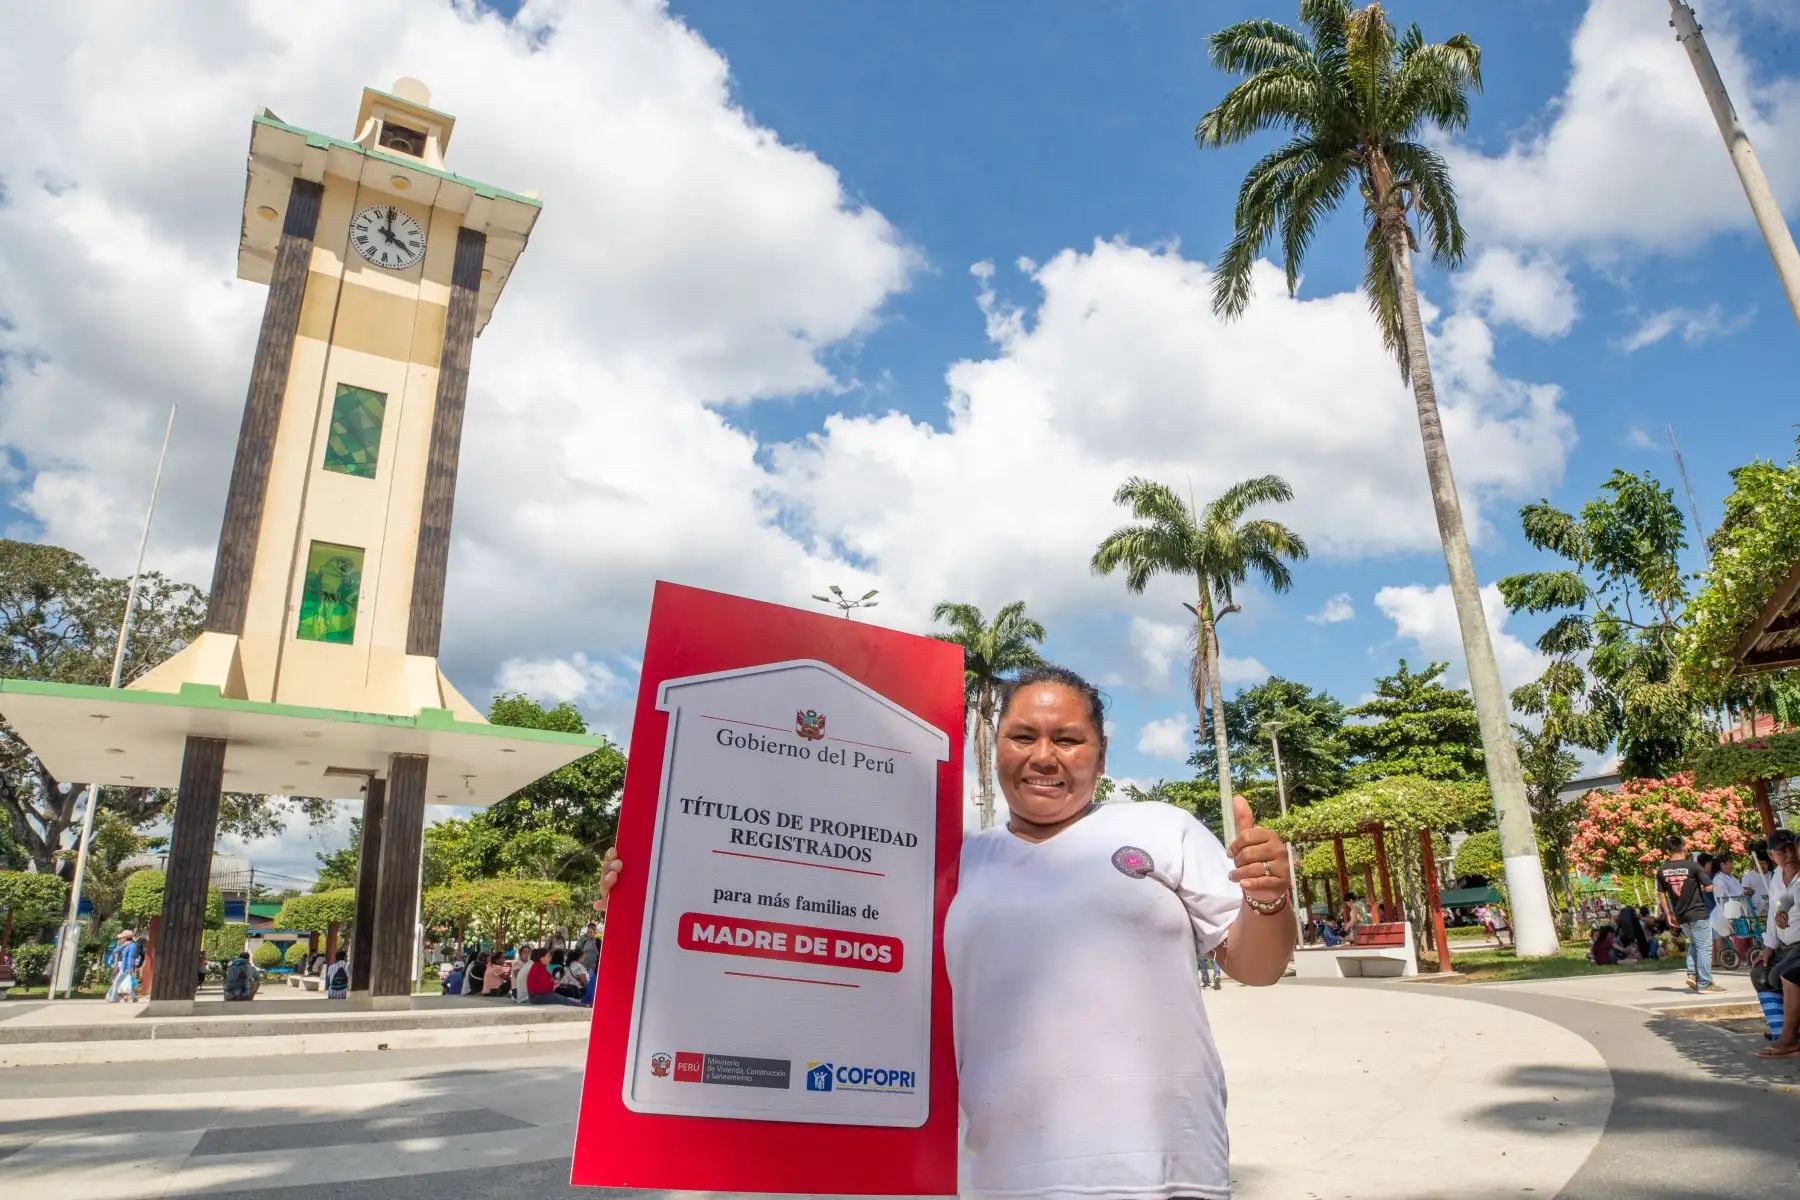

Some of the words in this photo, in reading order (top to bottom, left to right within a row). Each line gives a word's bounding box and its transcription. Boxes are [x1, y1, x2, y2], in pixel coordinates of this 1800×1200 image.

[716, 728, 811, 760] Gobierno
[817, 746, 846, 766] del
[853, 751, 895, 775] Perú
[680, 796, 770, 826] TÍTULOS
[776, 812, 803, 830] DE
[809, 817, 918, 848] PROPIEDAD
[730, 828, 872, 863] REGISTRADOS
[713, 888, 752, 904] para
[757, 893, 790, 909] más
[796, 896, 857, 917] familias
[862, 905, 880, 920] de
[692, 923, 787, 952] MADRE
[795, 935, 828, 957] DE
[835, 939, 893, 964] DIOS
[677, 1061, 700, 1072] PERÚ
[707, 1057, 740, 1066] Ministerio
[716, 1065, 744, 1075] Vivienda,
[746, 1068, 786, 1077] Construcción
[711, 1073, 753, 1081] Saneamiento
[836, 1066, 915, 1088] COFOPRI
